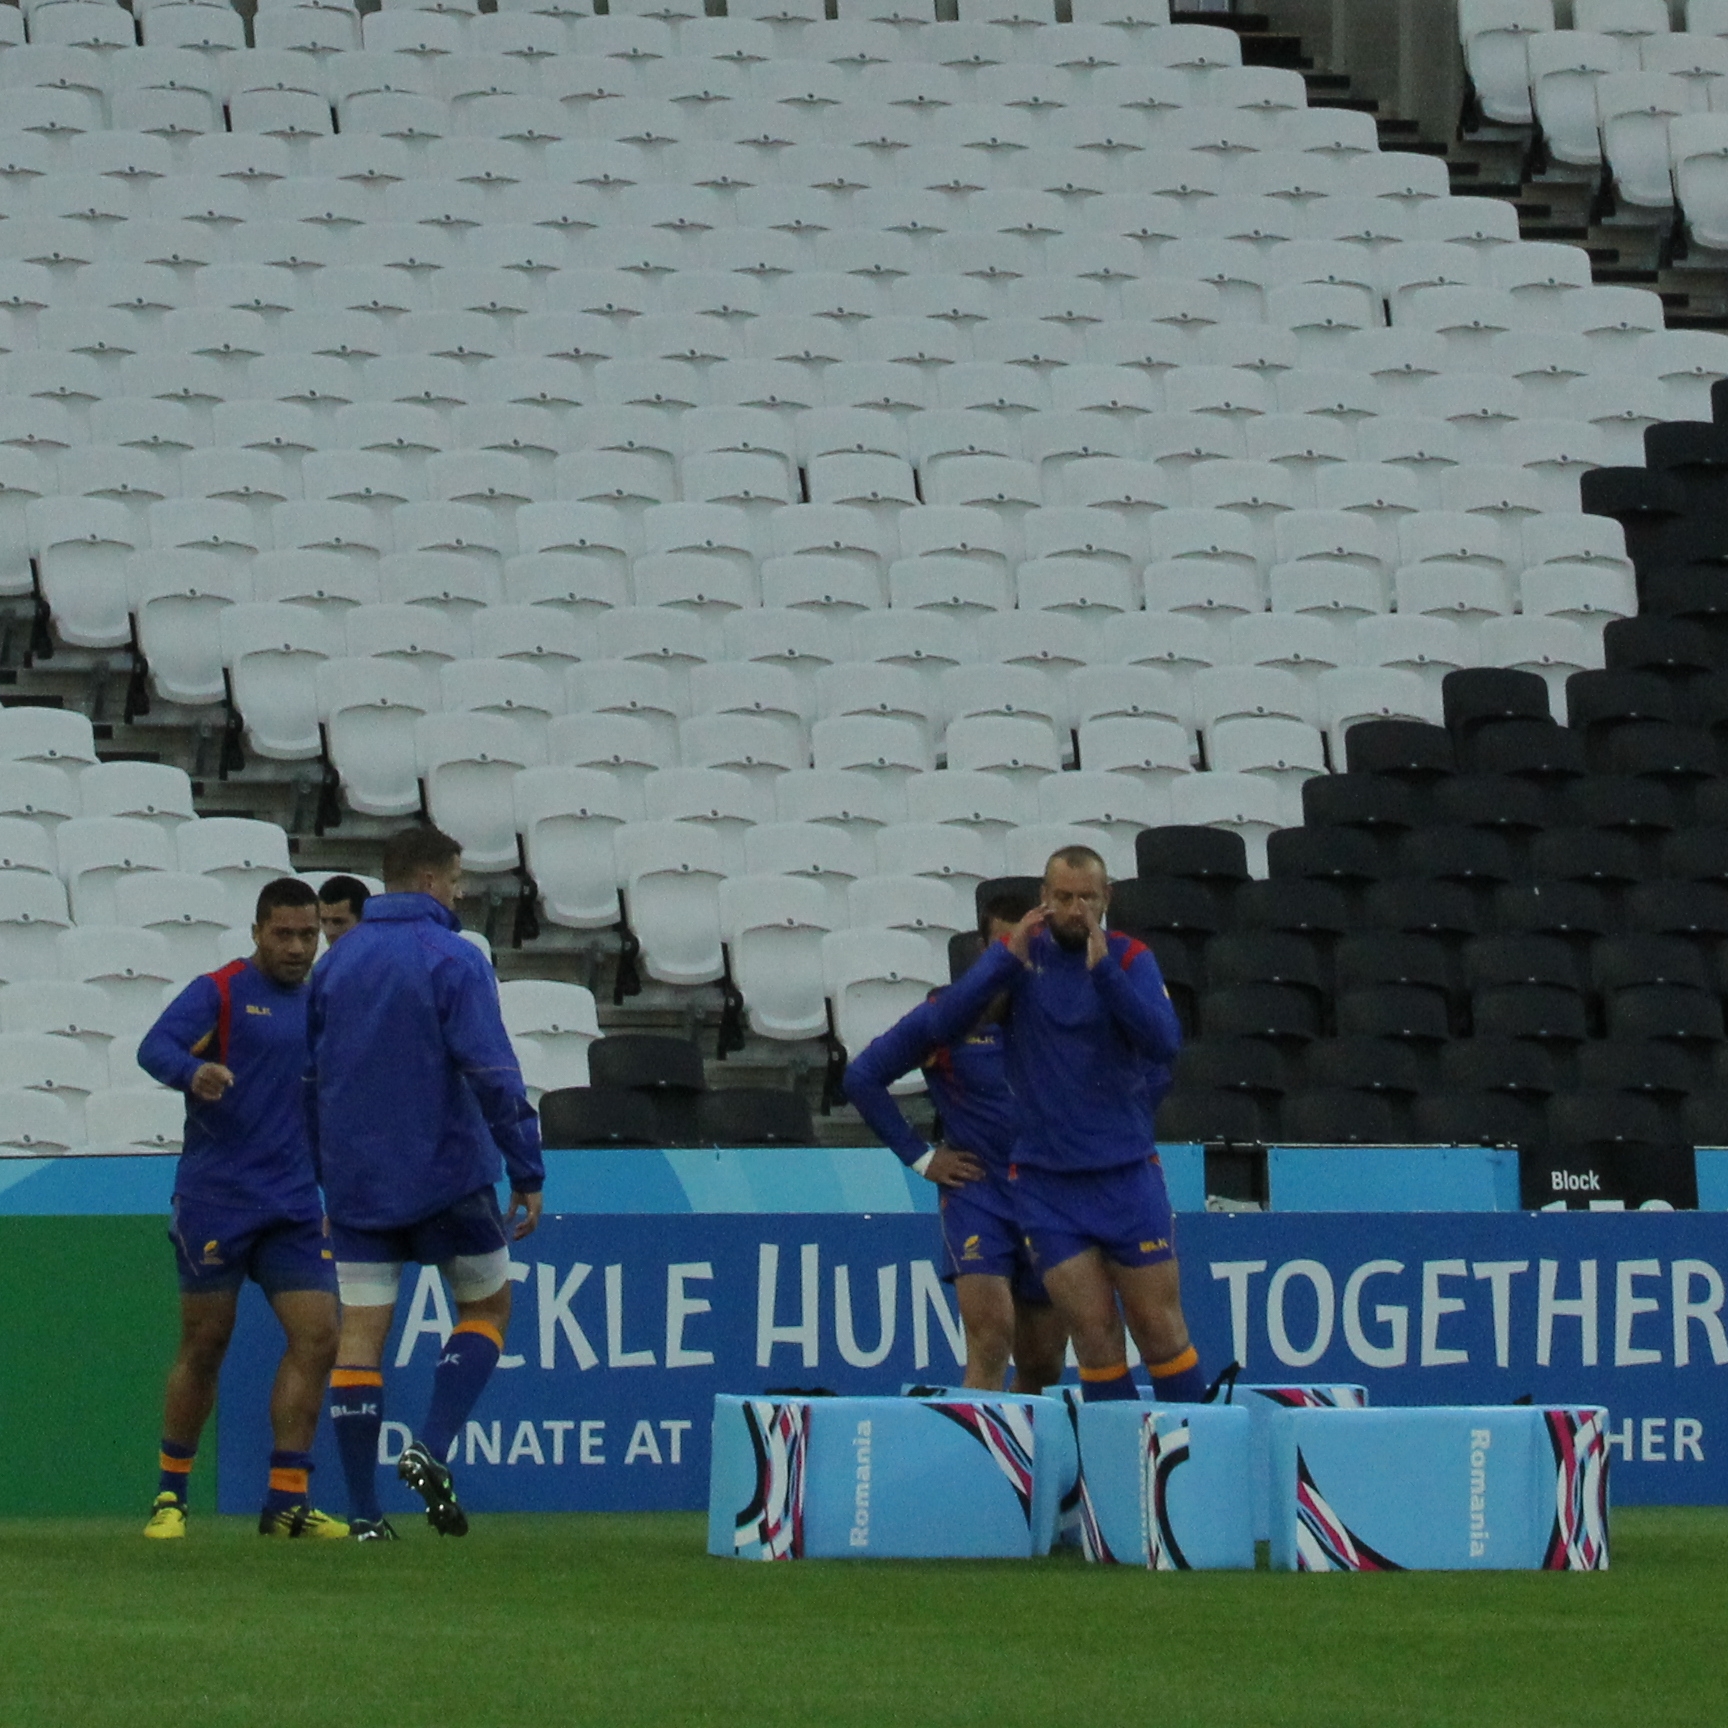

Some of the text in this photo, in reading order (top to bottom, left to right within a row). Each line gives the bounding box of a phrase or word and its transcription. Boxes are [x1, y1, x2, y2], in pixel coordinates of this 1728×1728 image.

[1551, 1170, 1600, 1190] Block
[625, 1420, 692, 1465] AT
[849, 1419, 871, 1548] Romania
[1470, 1428, 1493, 1558] Romania
